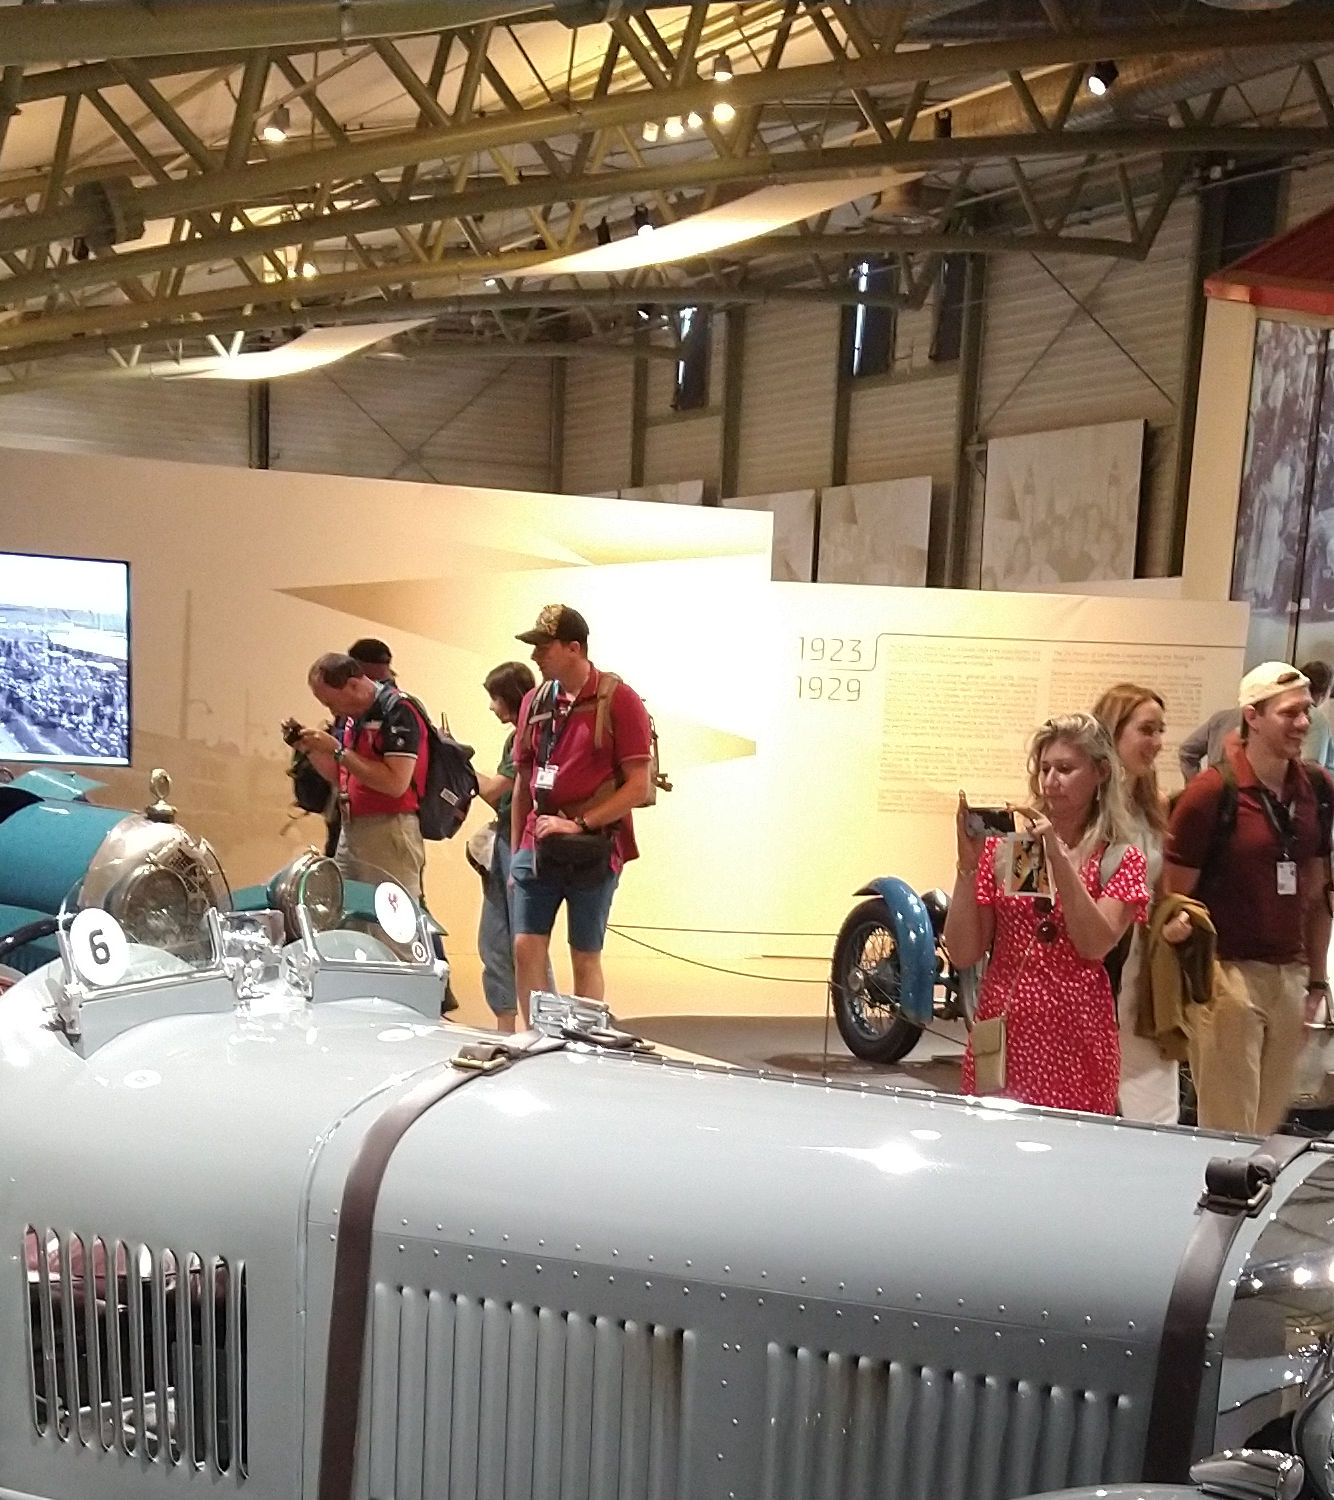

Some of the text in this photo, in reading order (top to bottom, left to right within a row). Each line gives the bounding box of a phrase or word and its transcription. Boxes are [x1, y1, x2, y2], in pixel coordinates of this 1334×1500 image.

[798, 636, 862, 663] 1923
[796, 674, 861, 702] 1929
[88, 928, 111, 965] 6
